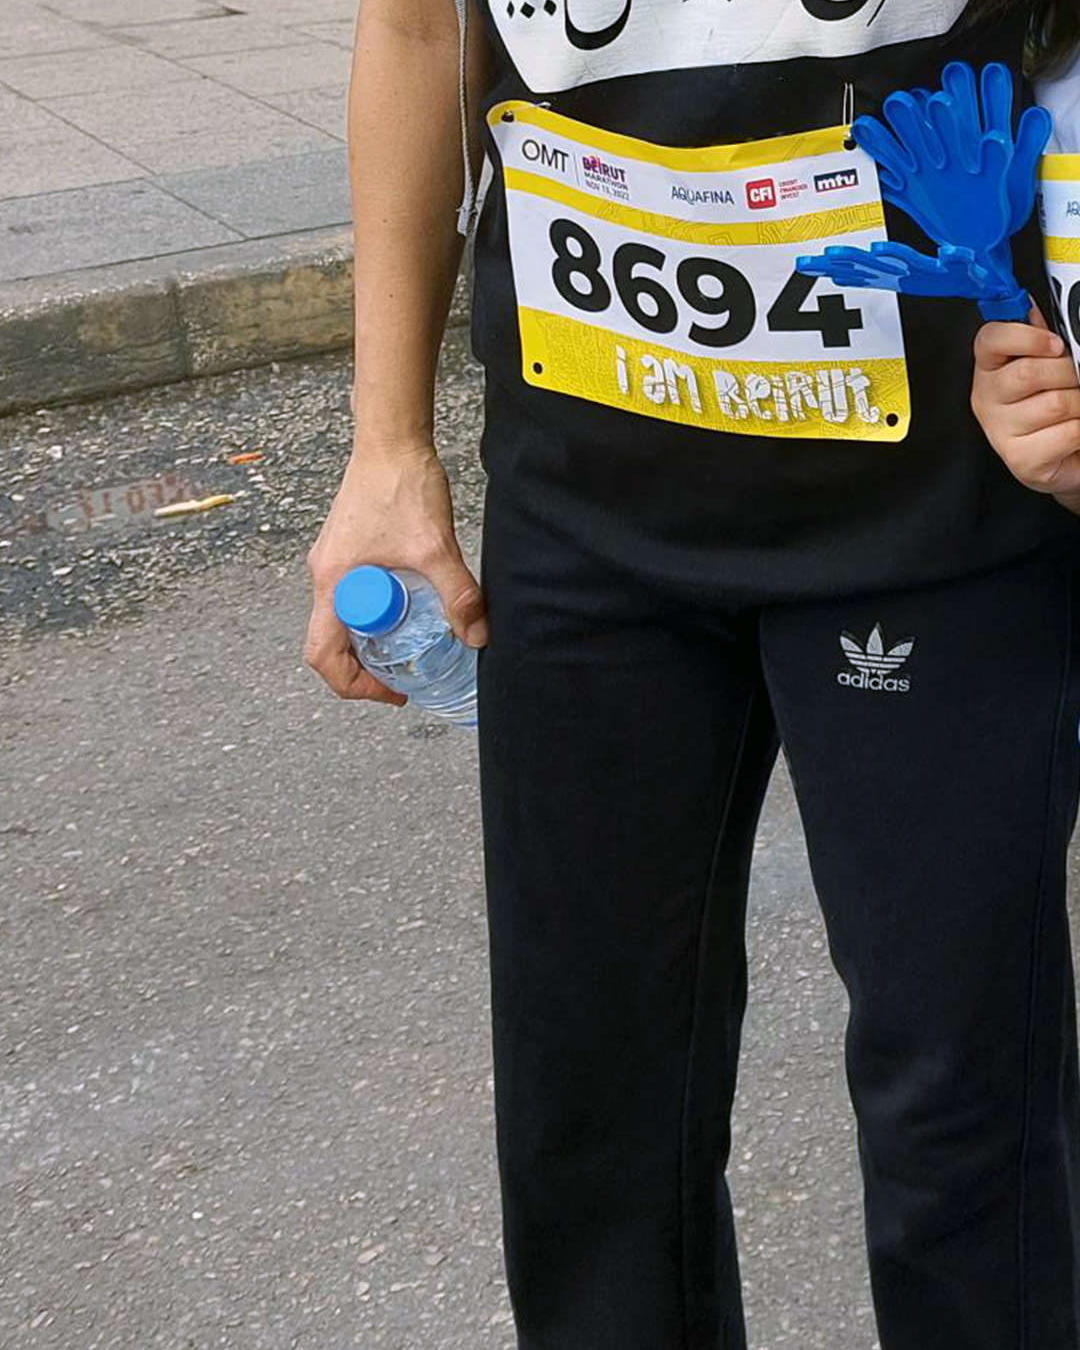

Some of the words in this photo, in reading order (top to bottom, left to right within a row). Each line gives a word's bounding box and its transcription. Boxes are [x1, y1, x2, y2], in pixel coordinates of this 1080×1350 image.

[522, 139, 569, 172] OMT
[582, 154, 626, 183] BEIRUT
[583, 170, 629, 191] MARATHON
[817, 173, 856, 191] mtv
[671, 185, 735, 205] AQUAFINA
[750, 186, 774, 203] CFI
[549, 218, 863, 348] 8694
[837, 671, 911, 692] adidas
